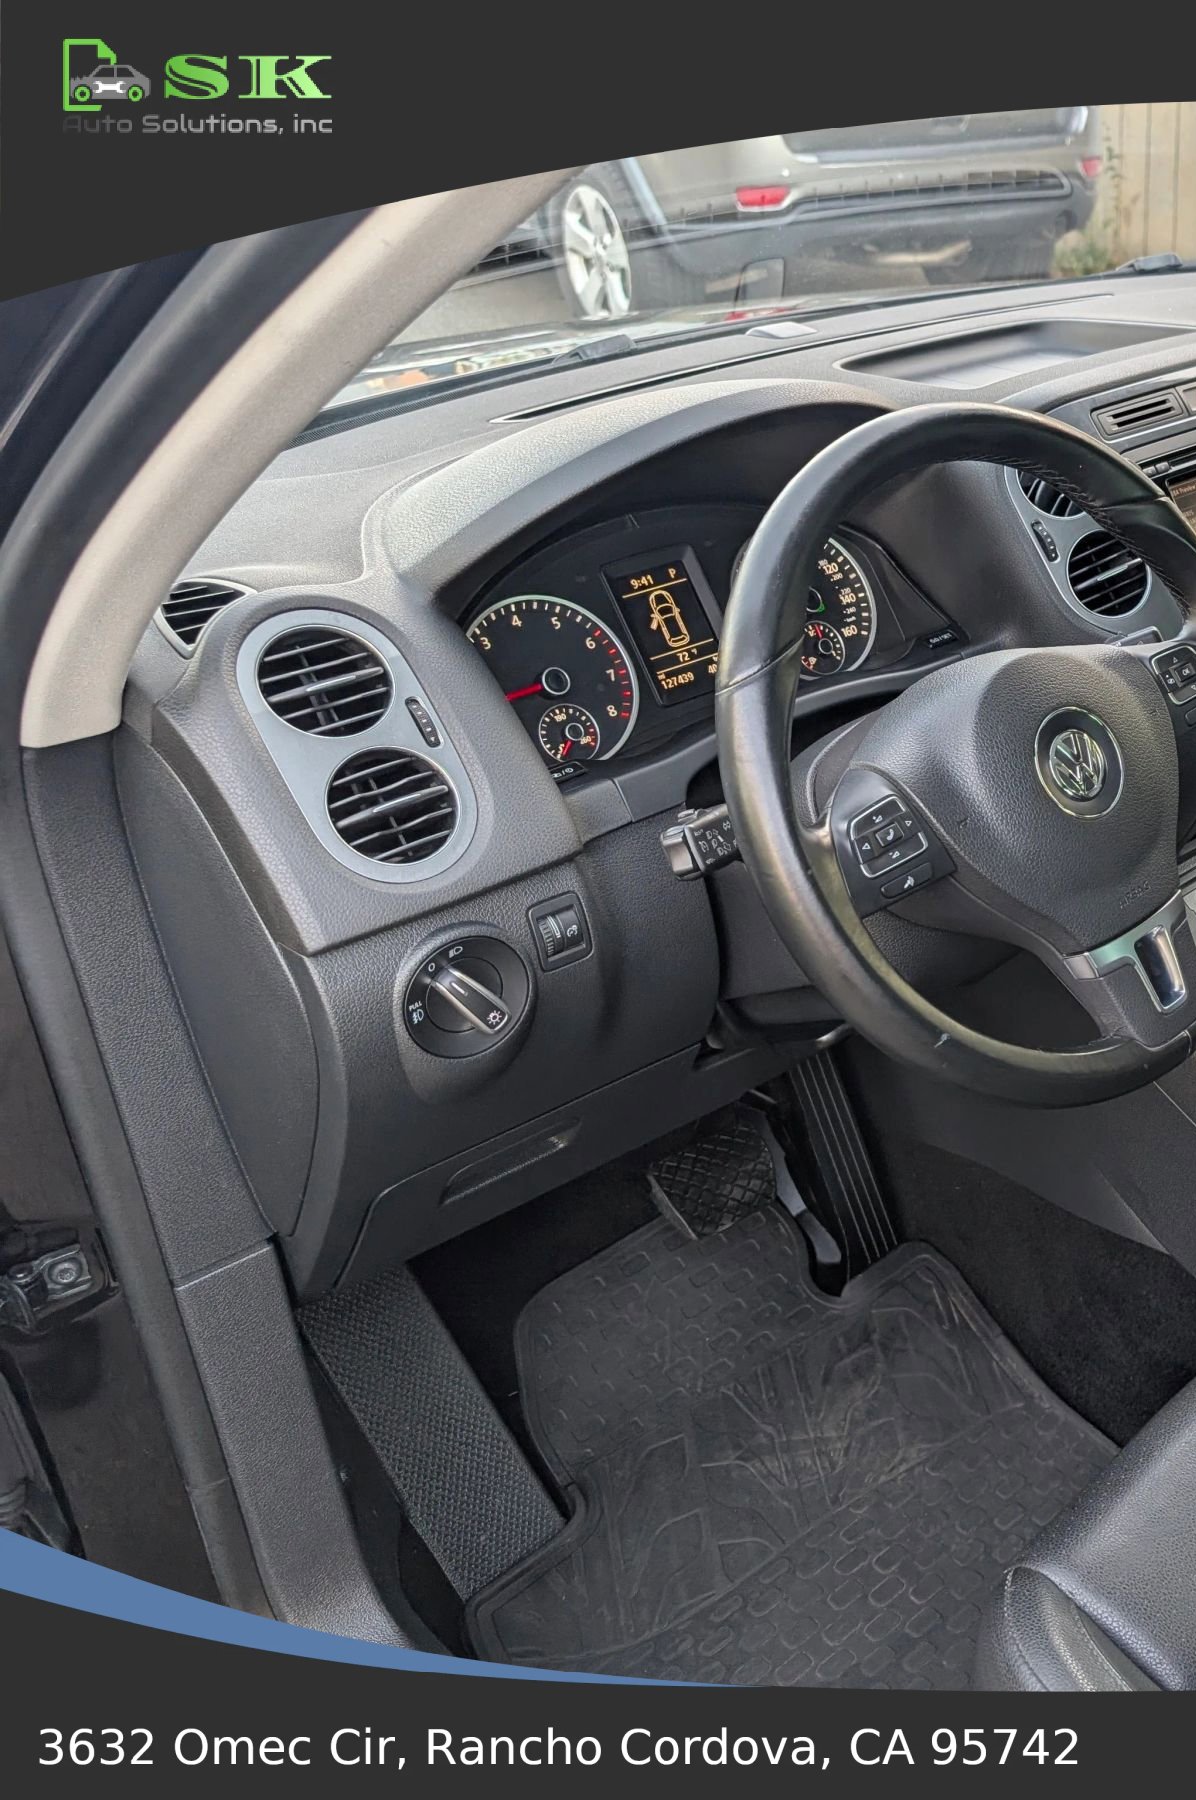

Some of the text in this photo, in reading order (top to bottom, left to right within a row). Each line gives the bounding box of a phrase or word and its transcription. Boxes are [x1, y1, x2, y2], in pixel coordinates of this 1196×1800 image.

[668, 568, 676, 578] P
[823, 562, 839, 574] 120
[630, 575, 654, 589] 9:41
[840, 592, 857, 605] 140
[512, 615, 522, 627] 4
[551, 617, 561, 629] 5
[841, 624, 858, 638] 160
[480, 637, 491, 650] 3
[585, 637, 596, 649] 6
[676, 651, 690, 662] 72
[605, 669, 615, 682] 7
[1182, 668, 1191, 676] OK
[661, 672, 695, 690] 127439
[606, 704, 618, 717] 8
[408, 1000, 423, 1012] PULL
